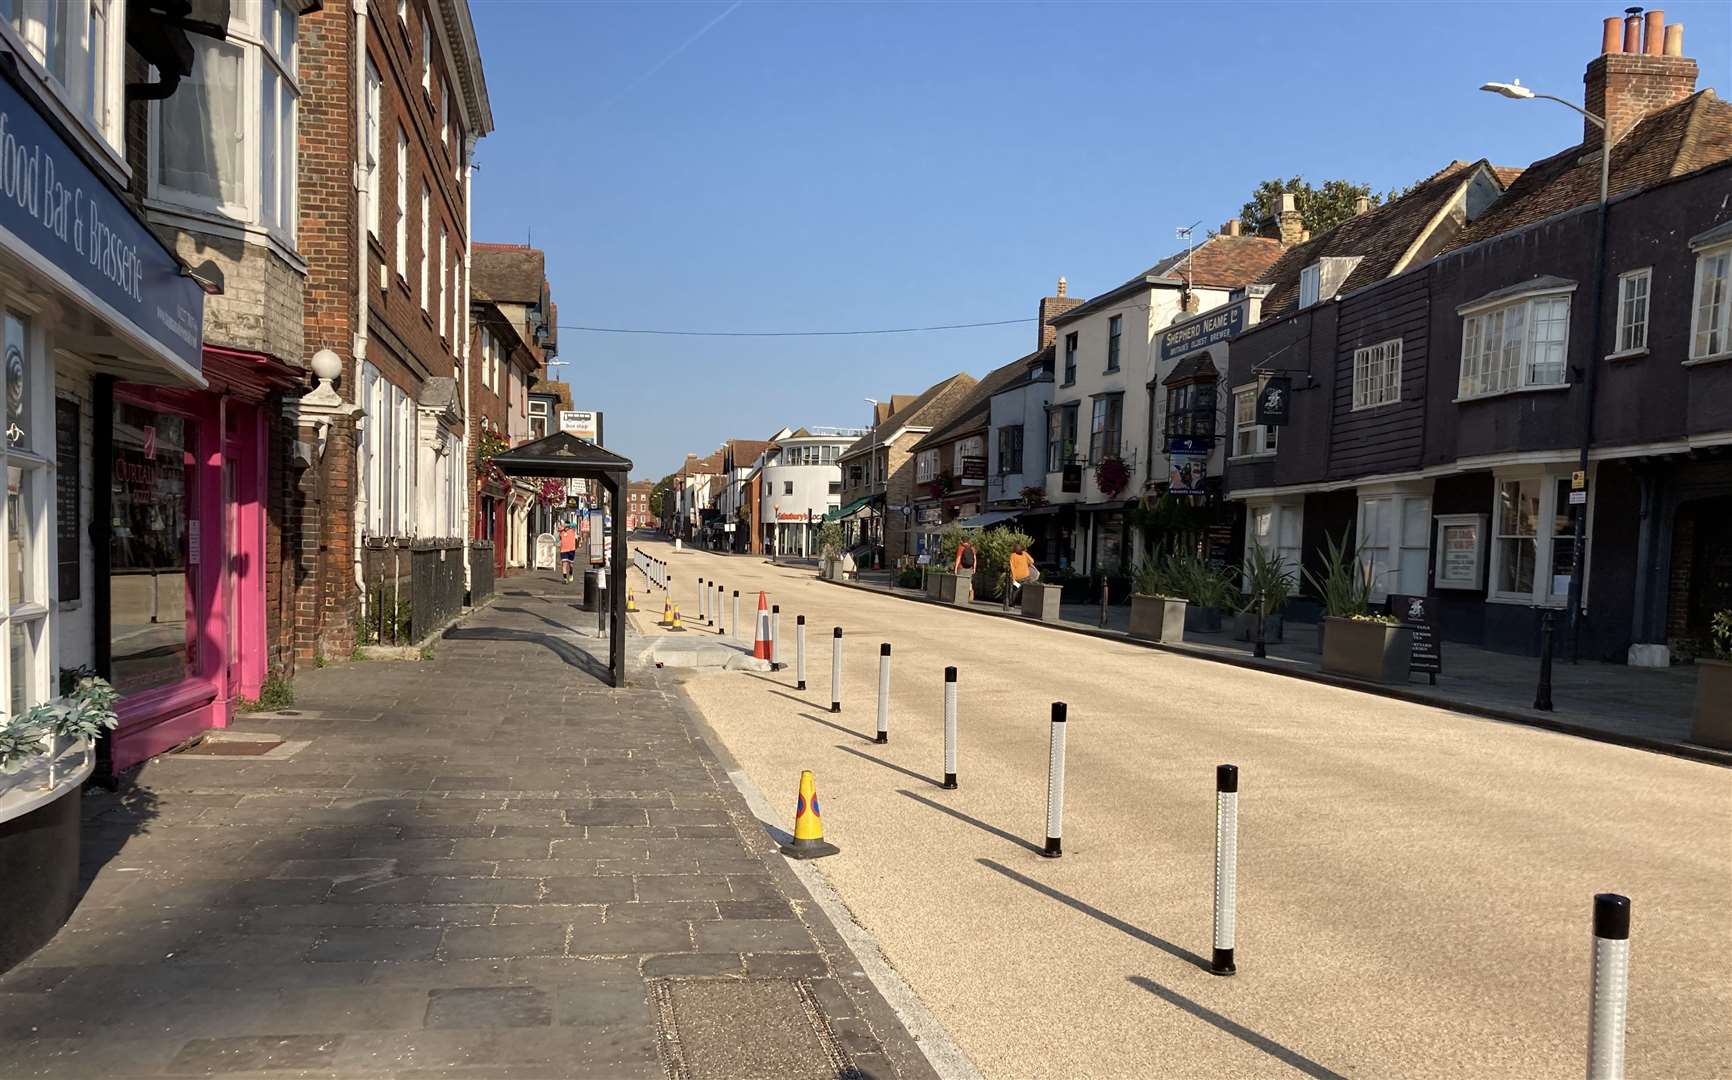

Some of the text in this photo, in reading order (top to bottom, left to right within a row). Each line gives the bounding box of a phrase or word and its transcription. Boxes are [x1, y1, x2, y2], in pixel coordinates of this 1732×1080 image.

[43, 153, 72, 243] Bar
[74, 188, 85, 256] &
[90, 200, 143, 303] Brasserie
[1166, 324, 1201, 347] SHEPHERD
[1203, 313, 1228, 334] NEAME
